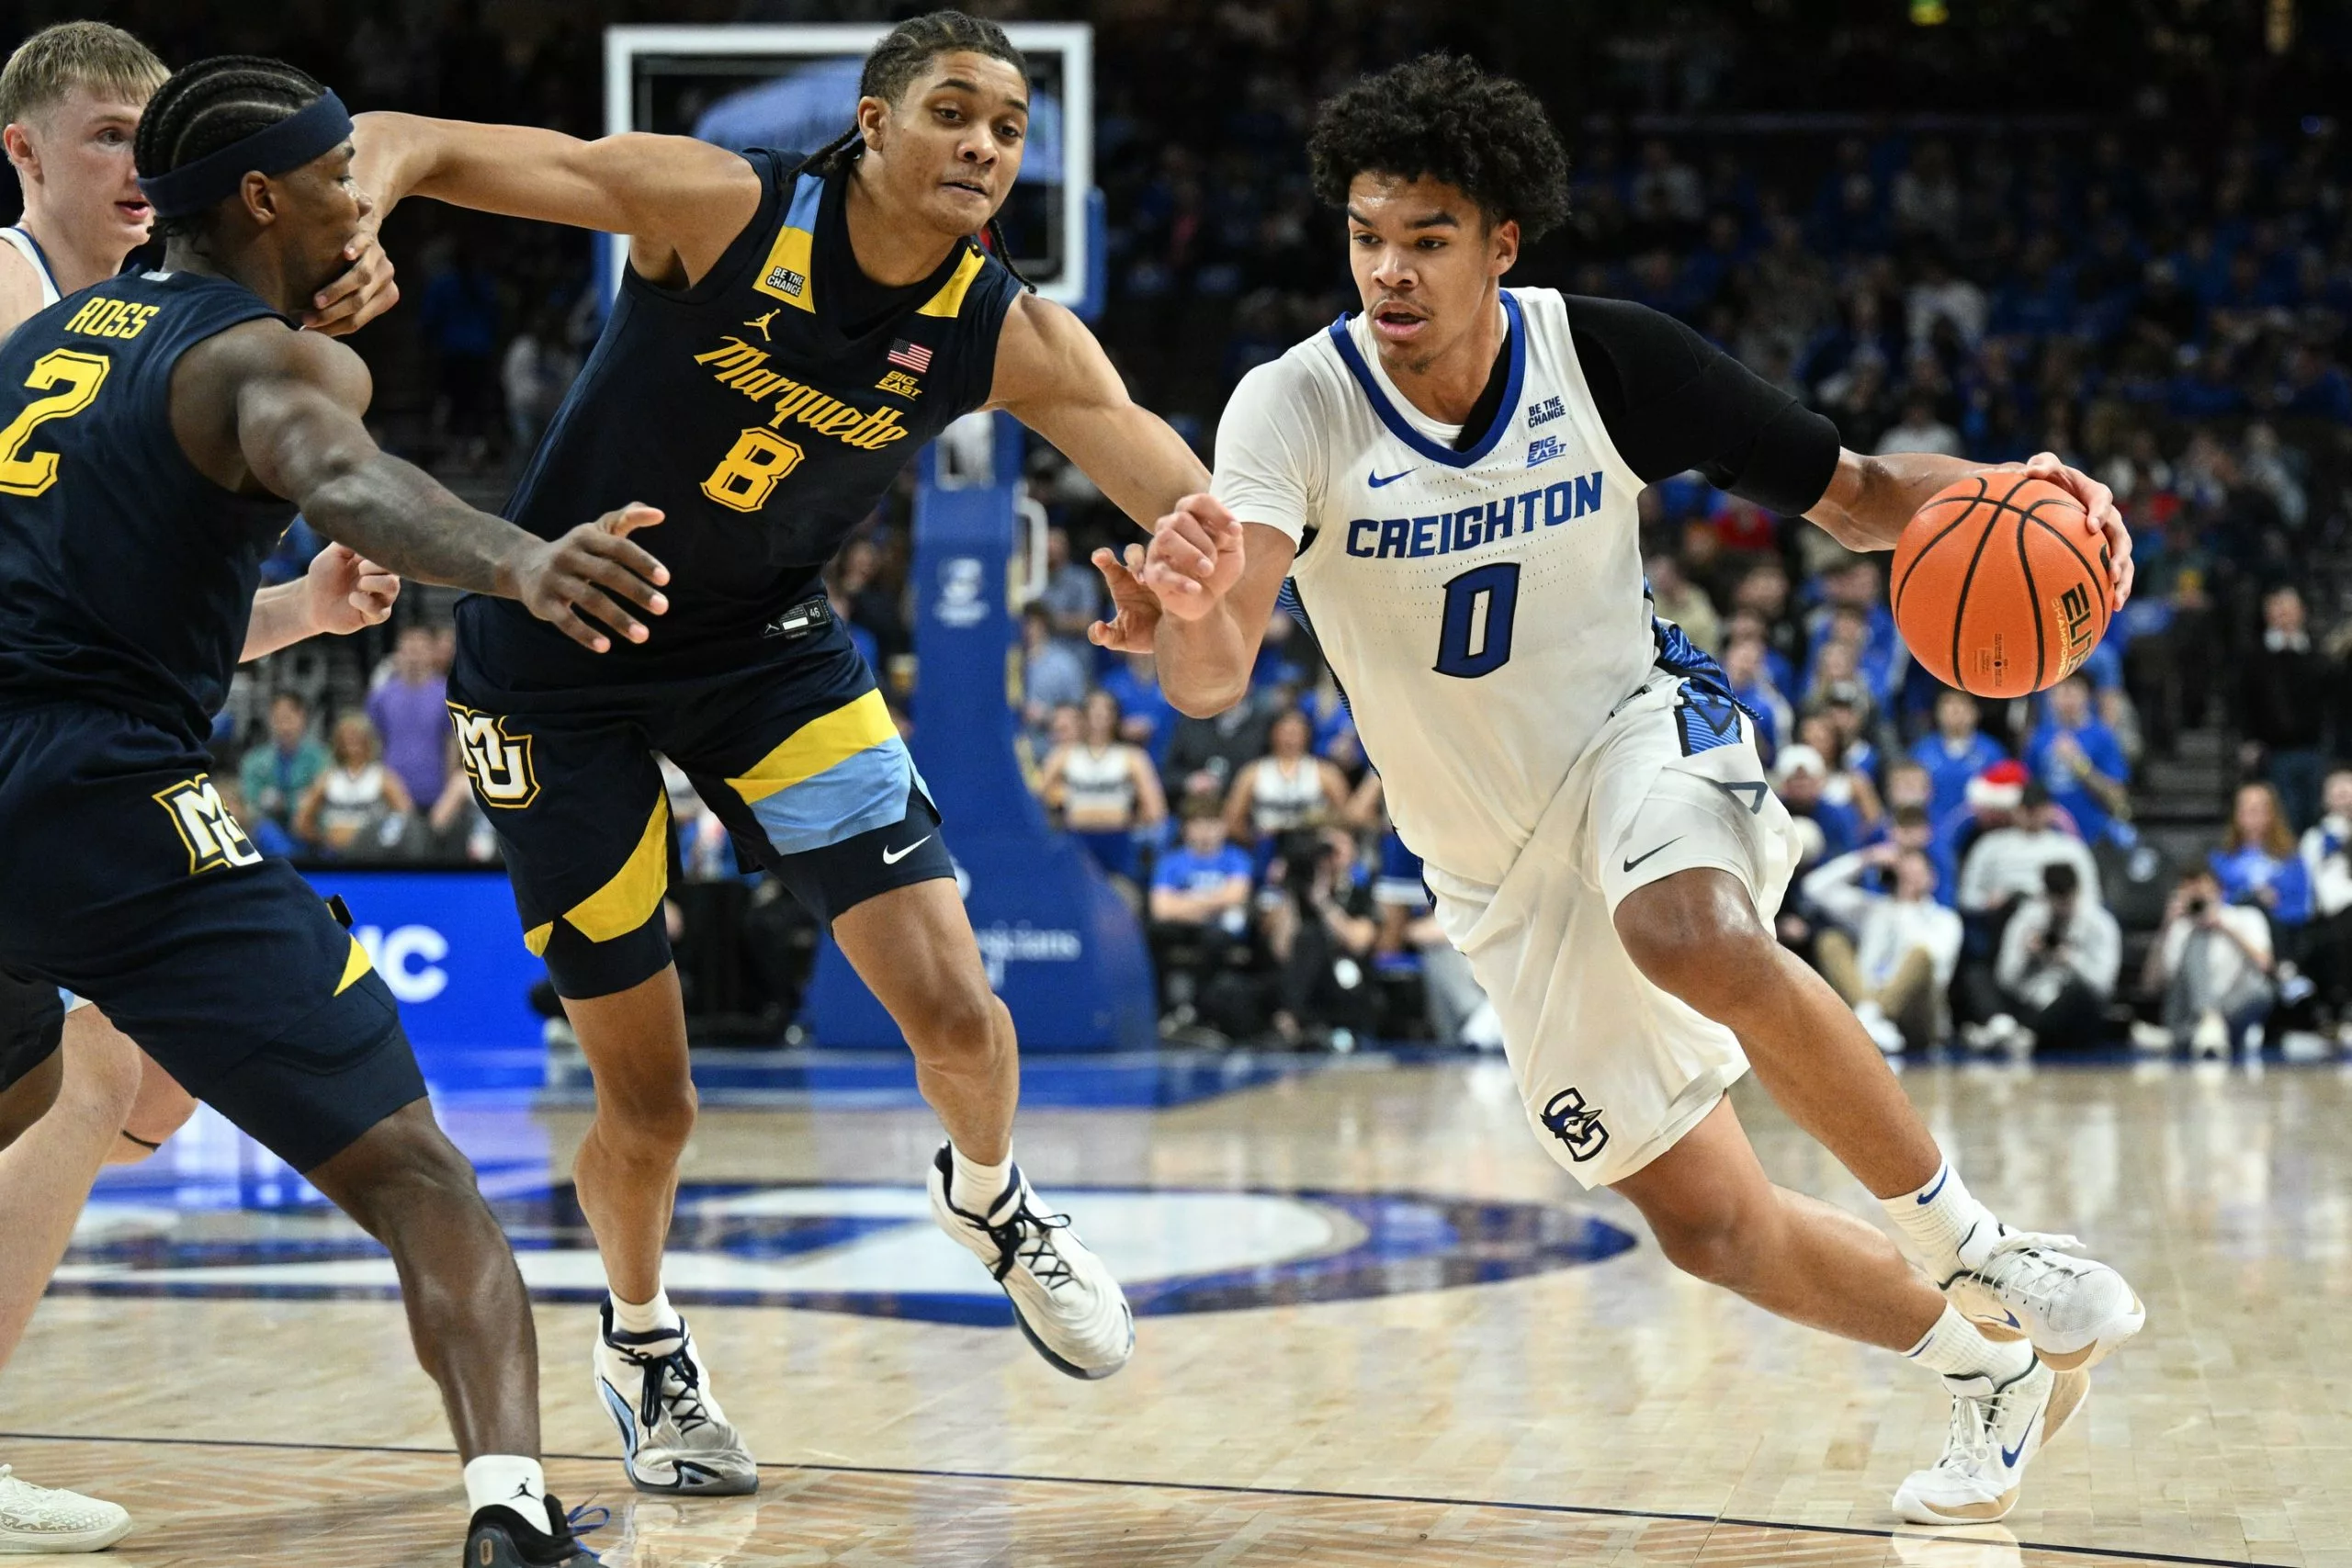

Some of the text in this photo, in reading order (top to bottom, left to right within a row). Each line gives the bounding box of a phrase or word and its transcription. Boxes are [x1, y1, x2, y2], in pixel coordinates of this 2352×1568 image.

[766, 275, 802, 296] CHANGE
[774, 266, 805, 286] BE THE
[64, 297, 160, 339] ROSS
[878, 377, 922, 397] EAST
[887, 370, 919, 386] BIG
[694, 335, 909, 450] Marquette
[1528, 395, 1562, 417] BE THE
[1528, 404, 1566, 428] CHANGE
[0, 347, 110, 498] 2
[1527, 443, 1567, 463] EAST
[1529, 434, 1556, 453] BIG
[699, 426, 805, 513] 8
[1346, 470, 1603, 559] CREIGHTON
[1431, 561, 1521, 679] 0
